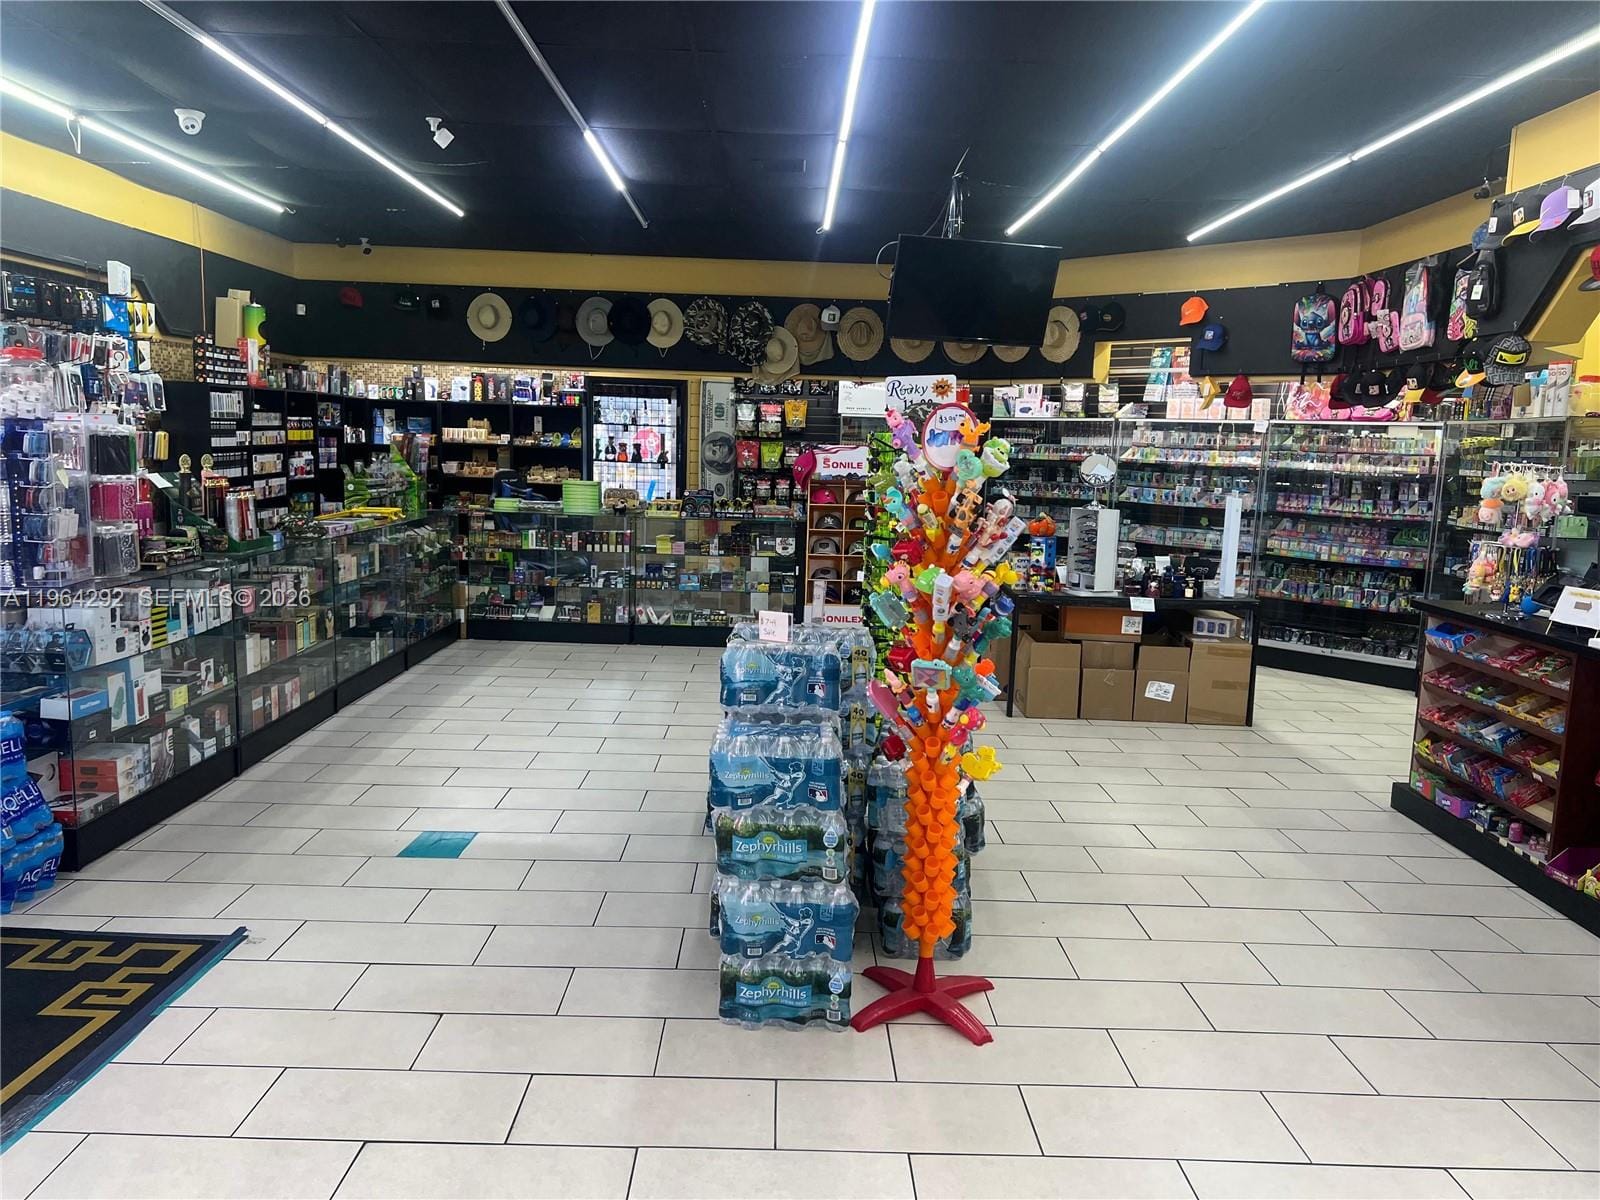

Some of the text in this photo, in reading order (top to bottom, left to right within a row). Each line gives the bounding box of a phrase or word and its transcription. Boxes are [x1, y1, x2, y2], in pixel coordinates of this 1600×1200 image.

[854, 649, 867, 657] 40
[852, 707, 865, 716] 40
[735, 839, 802, 854] Zephyrhills
[739, 986, 807, 1000] Zephyrhills
